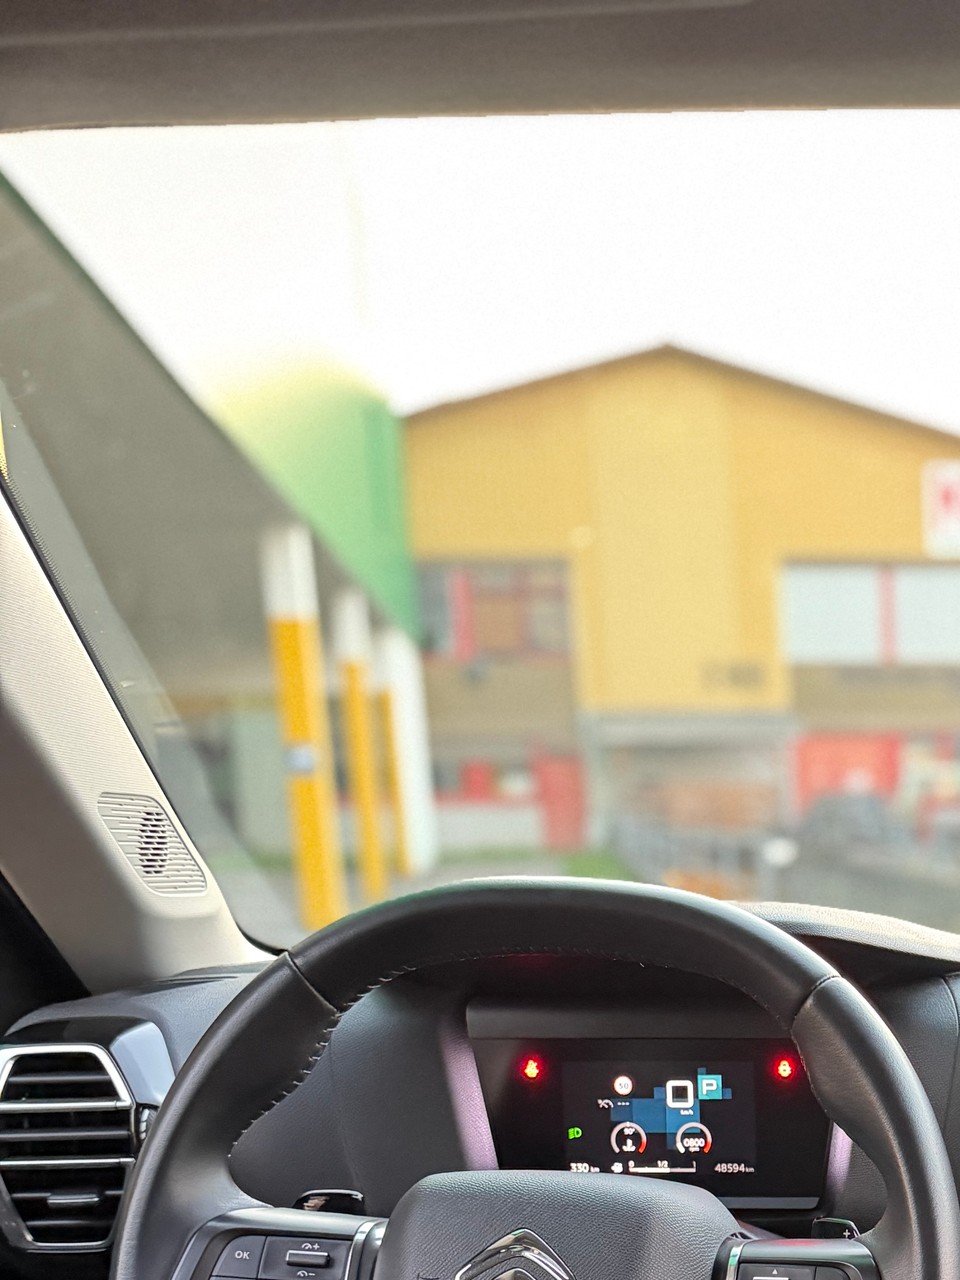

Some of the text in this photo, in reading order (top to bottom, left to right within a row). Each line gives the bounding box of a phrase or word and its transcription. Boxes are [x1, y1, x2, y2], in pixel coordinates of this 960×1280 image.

[702, 1079, 717, 1095] P
[570, 1163, 590, 1173] 330
[714, 1163, 746, 1173] 48594
[234, 1250, 250, 1260] OK
